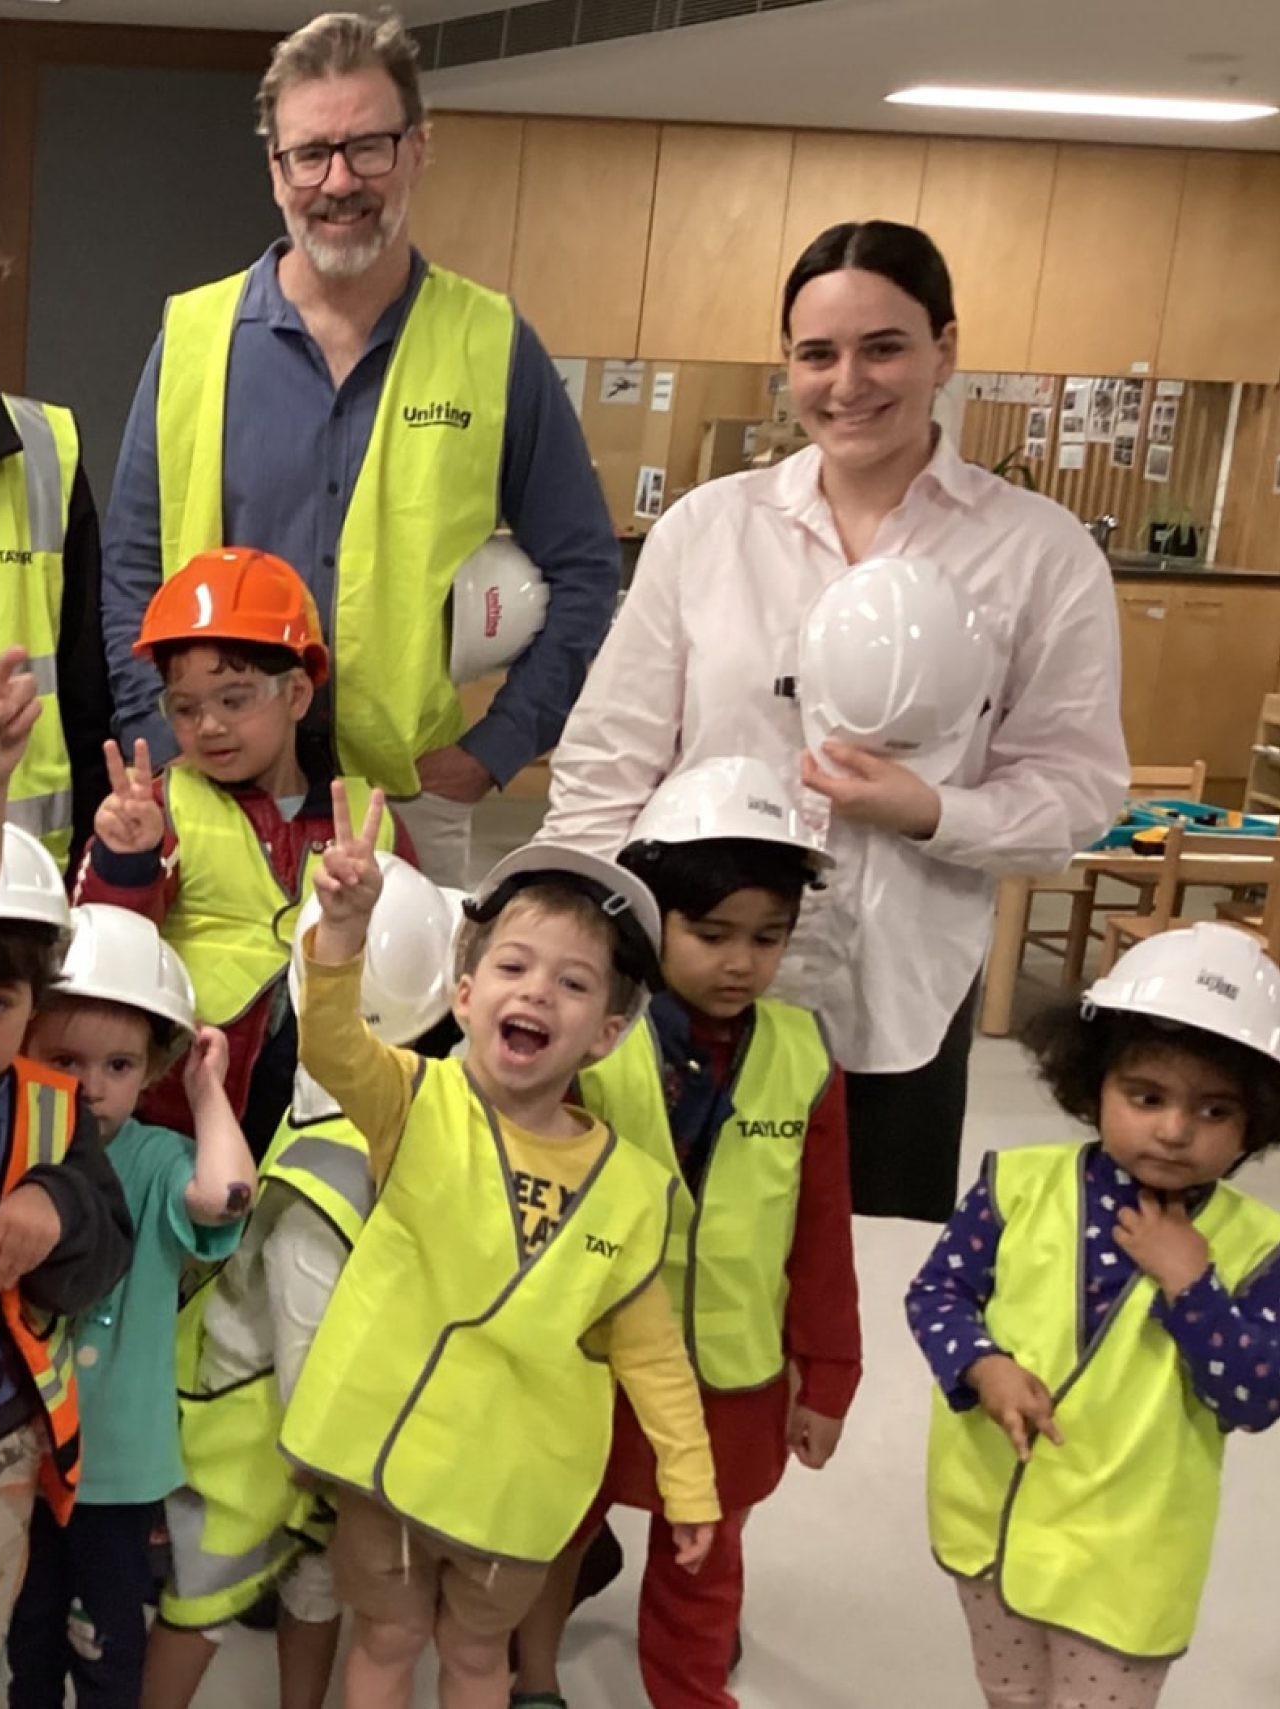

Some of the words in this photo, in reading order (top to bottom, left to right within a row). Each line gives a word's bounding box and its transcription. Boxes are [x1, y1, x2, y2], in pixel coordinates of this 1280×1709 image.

[404, 401, 472, 430] Uniting
[737, 1120, 804, 1139] TAYLOR
[513, 1170, 552, 1210] EE
[585, 1233, 624, 1259] TAY
